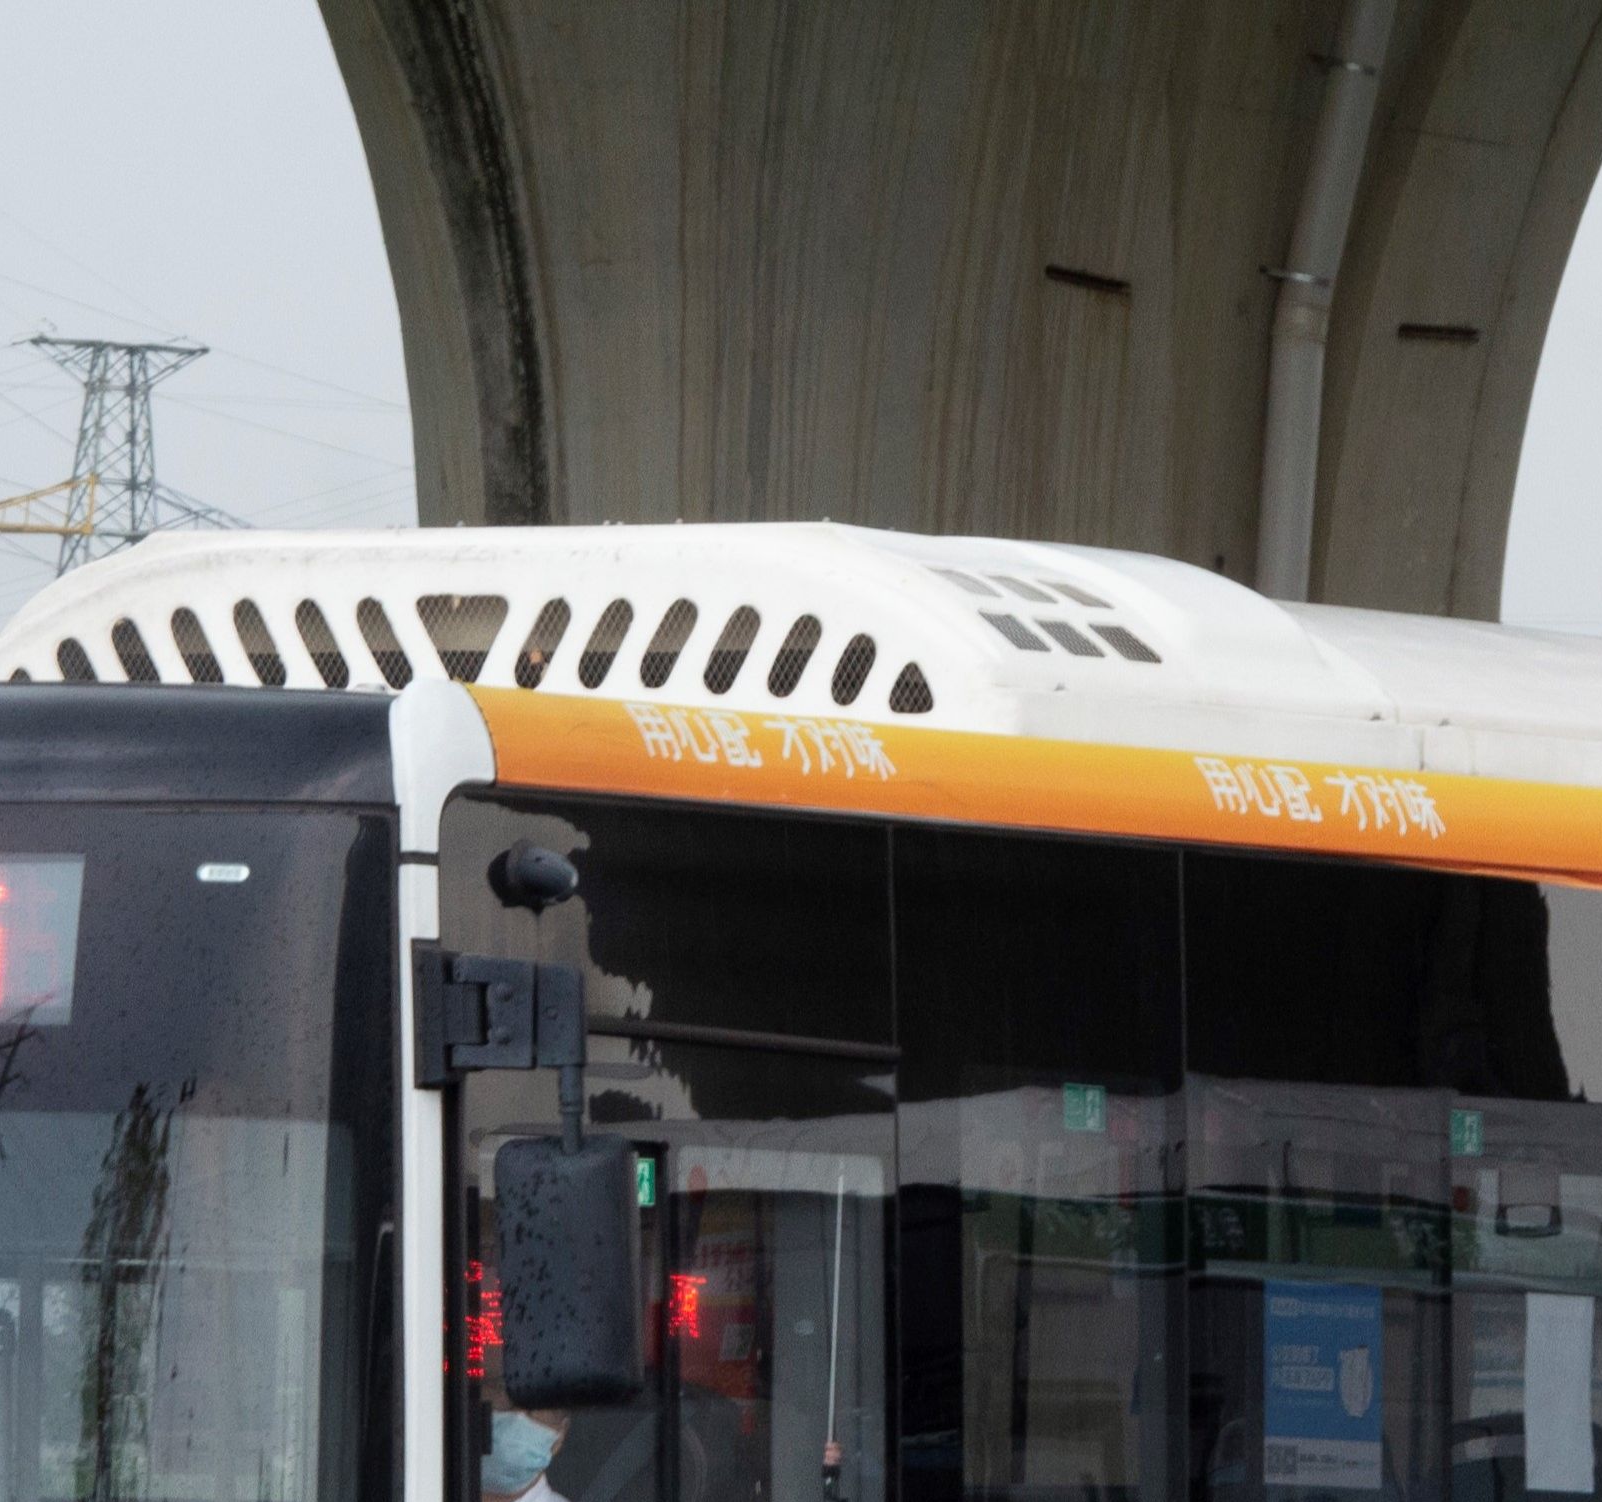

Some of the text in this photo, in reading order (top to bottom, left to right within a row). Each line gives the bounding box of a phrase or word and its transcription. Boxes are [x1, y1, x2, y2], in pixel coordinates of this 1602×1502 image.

[626, 703, 896, 781] 用心配 才对味
[1194, 756, 1446, 837] 用心配 才对味
